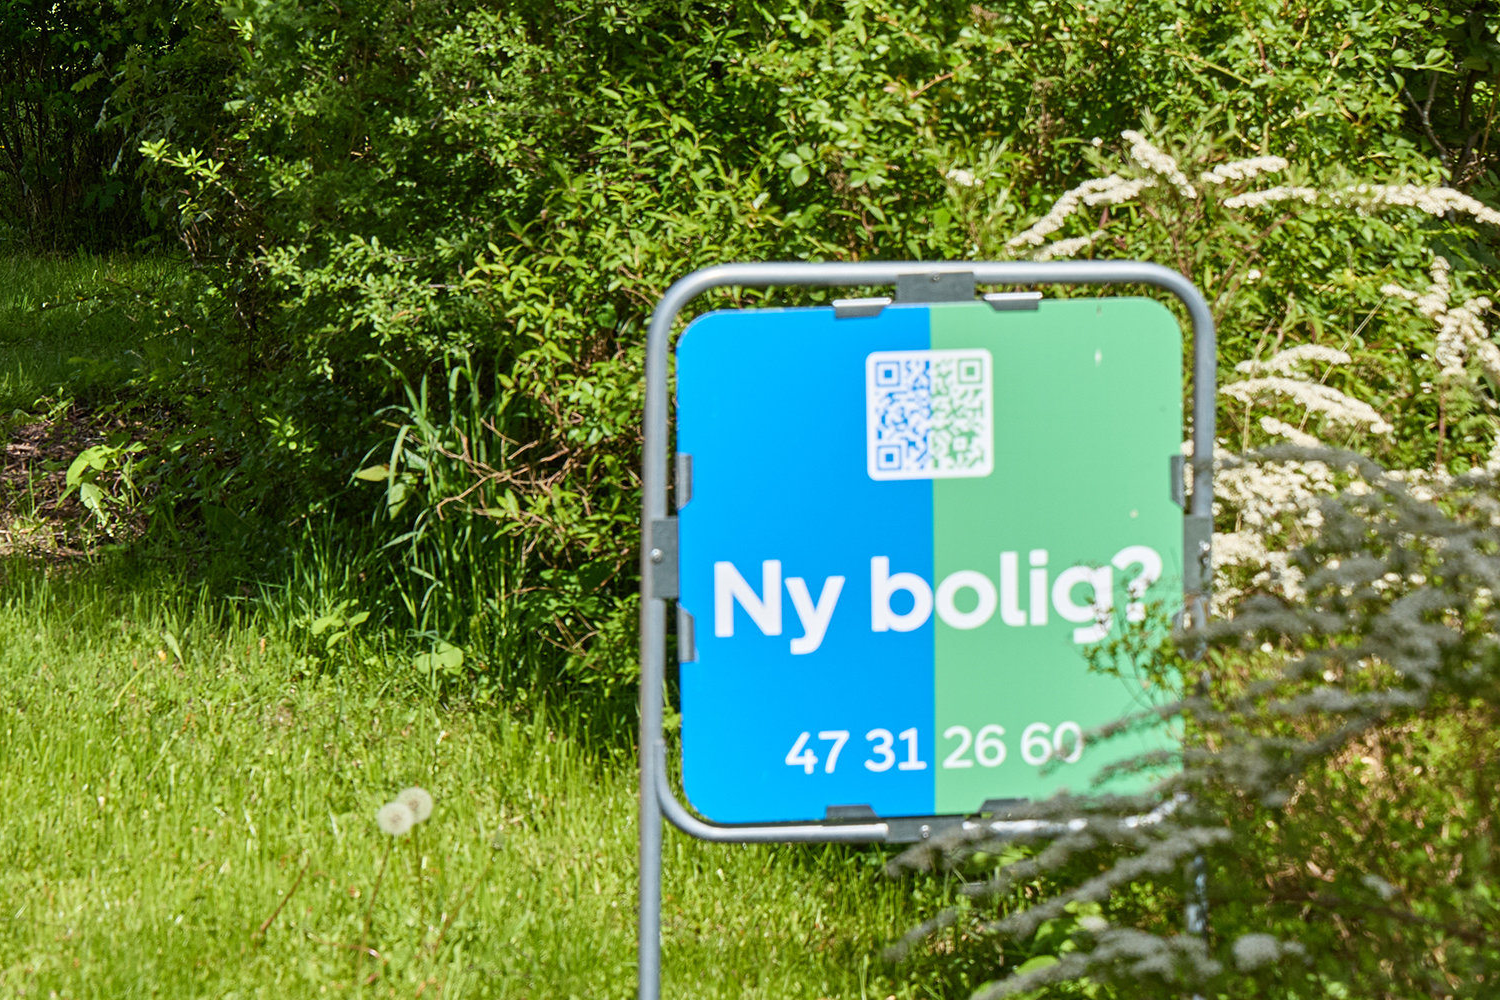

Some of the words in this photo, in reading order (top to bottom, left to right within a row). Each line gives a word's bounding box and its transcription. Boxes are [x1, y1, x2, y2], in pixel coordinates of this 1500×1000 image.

[714, 559, 844, 655] Ny
[871, 545, 1163, 644] bolig?
[785, 730, 849, 774] 47
[865, 727, 926, 771] 31
[942, 724, 1007, 770] 26
[1020, 721, 1085, 764] 60
